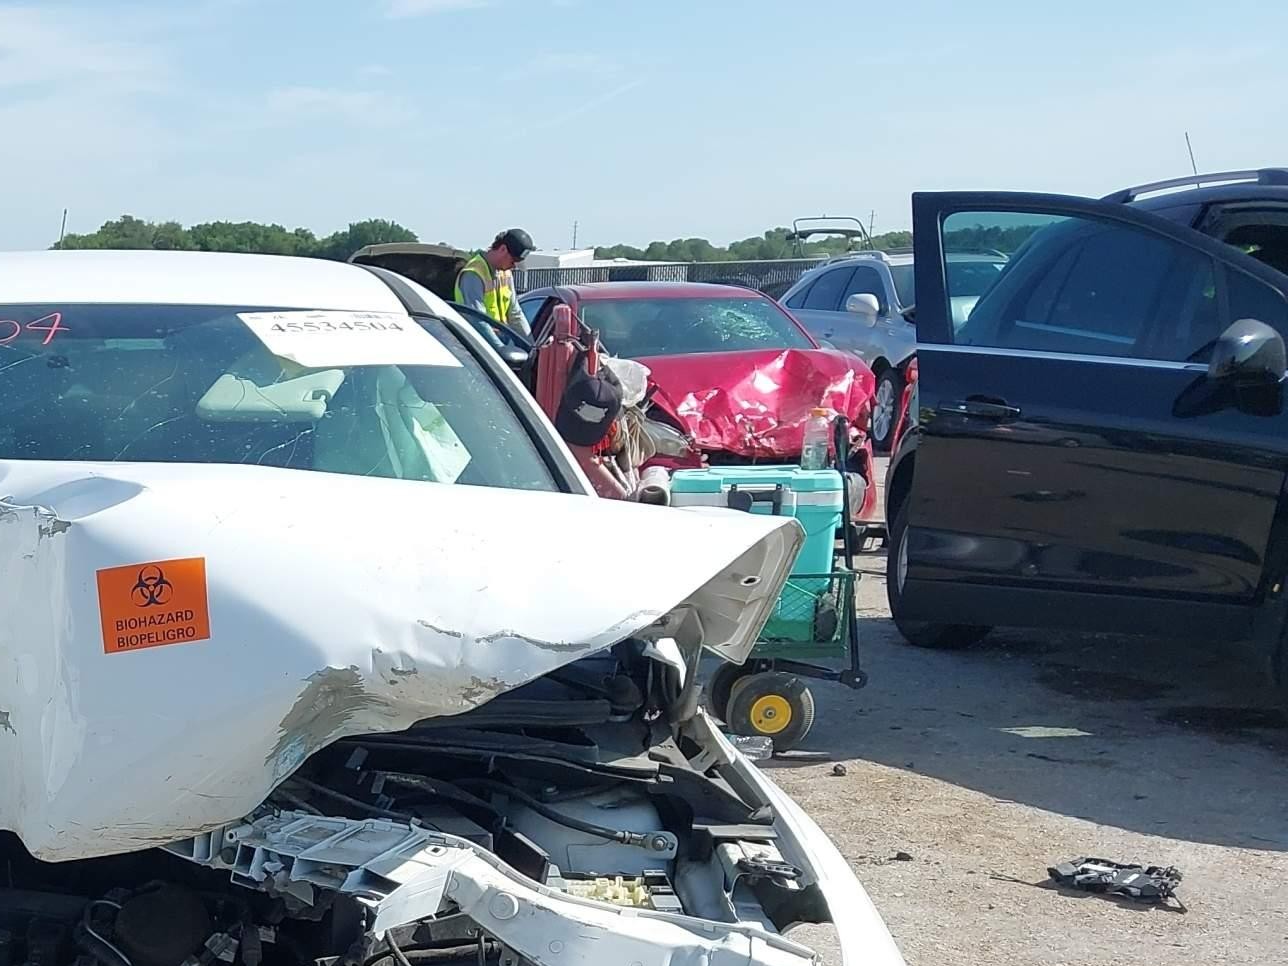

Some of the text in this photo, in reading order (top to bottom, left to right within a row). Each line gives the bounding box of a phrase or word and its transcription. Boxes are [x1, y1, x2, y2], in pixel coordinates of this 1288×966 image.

[270, 320, 404, 333] 45534504
[115, 609, 194, 632] BIOHAZARD
[117, 626, 195, 648] BIOPELIGRO
